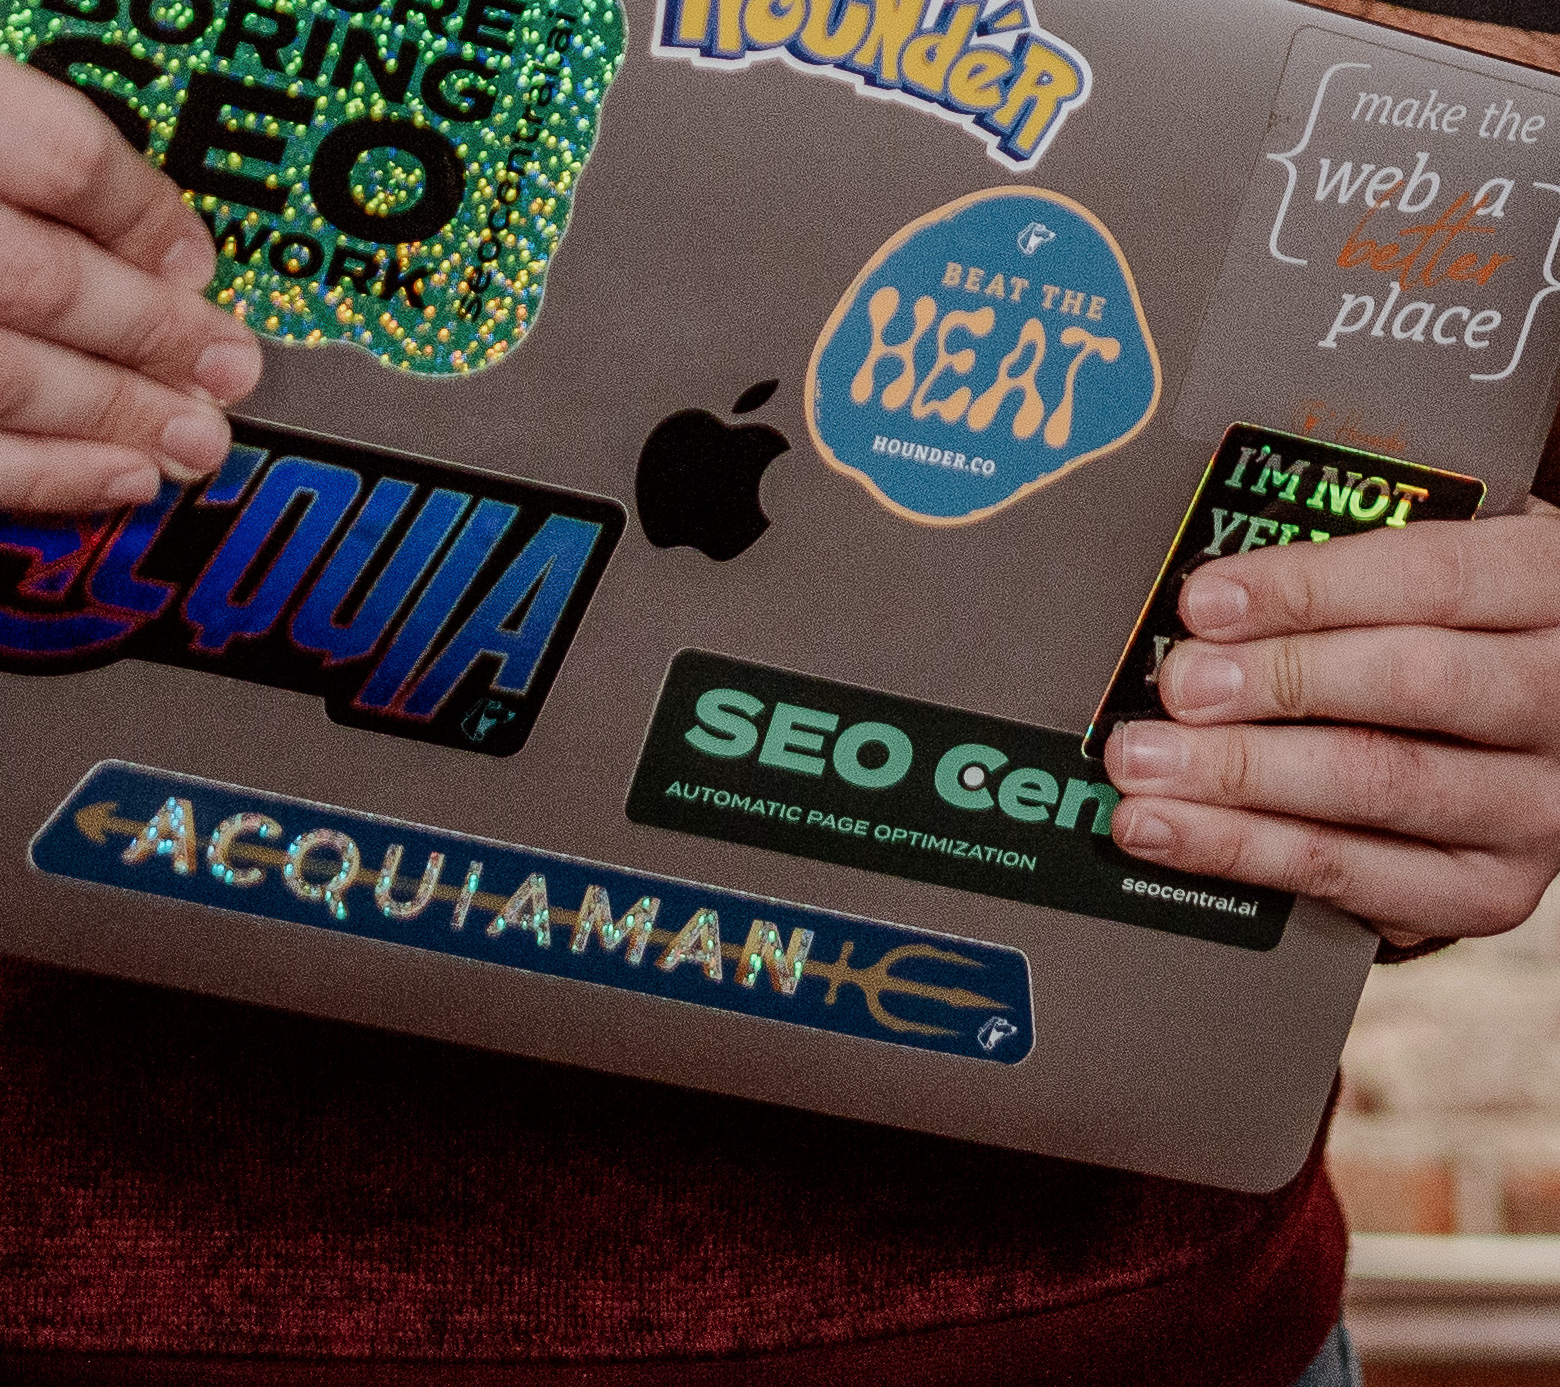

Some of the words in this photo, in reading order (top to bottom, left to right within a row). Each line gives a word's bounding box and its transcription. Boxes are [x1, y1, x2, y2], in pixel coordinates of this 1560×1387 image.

[1350, 89, 1467, 134] make
[1477, 99, 1546, 143] the
[1313, 152, 1440, 213] web
[1473, 176, 1516, 218] a
[1337, 180, 1516, 291] better
[943, 260, 1031, 302] BEAT
[1041, 283, 1108, 321] THE
[1317, 282, 1503, 348] place
[850, 285, 1121, 448] HEAT
[872, 435, 997, 476] HOUNDER.CO
[1224, 445, 1311, 503] I'M
[1306, 466, 1430, 528] NOT
[684, 687, 914, 788] SEO
[934, 743, 1122, 835] Cen
[665, 780, 805, 827] AUTOMATIC
[807, 809, 870, 837] PAGE
[874, 824, 1038, 872] OPTIMIZATION
[120, 796, 816, 996] ACQUIAMAN
[1121, 877, 1259, 917] seocentral.ai
